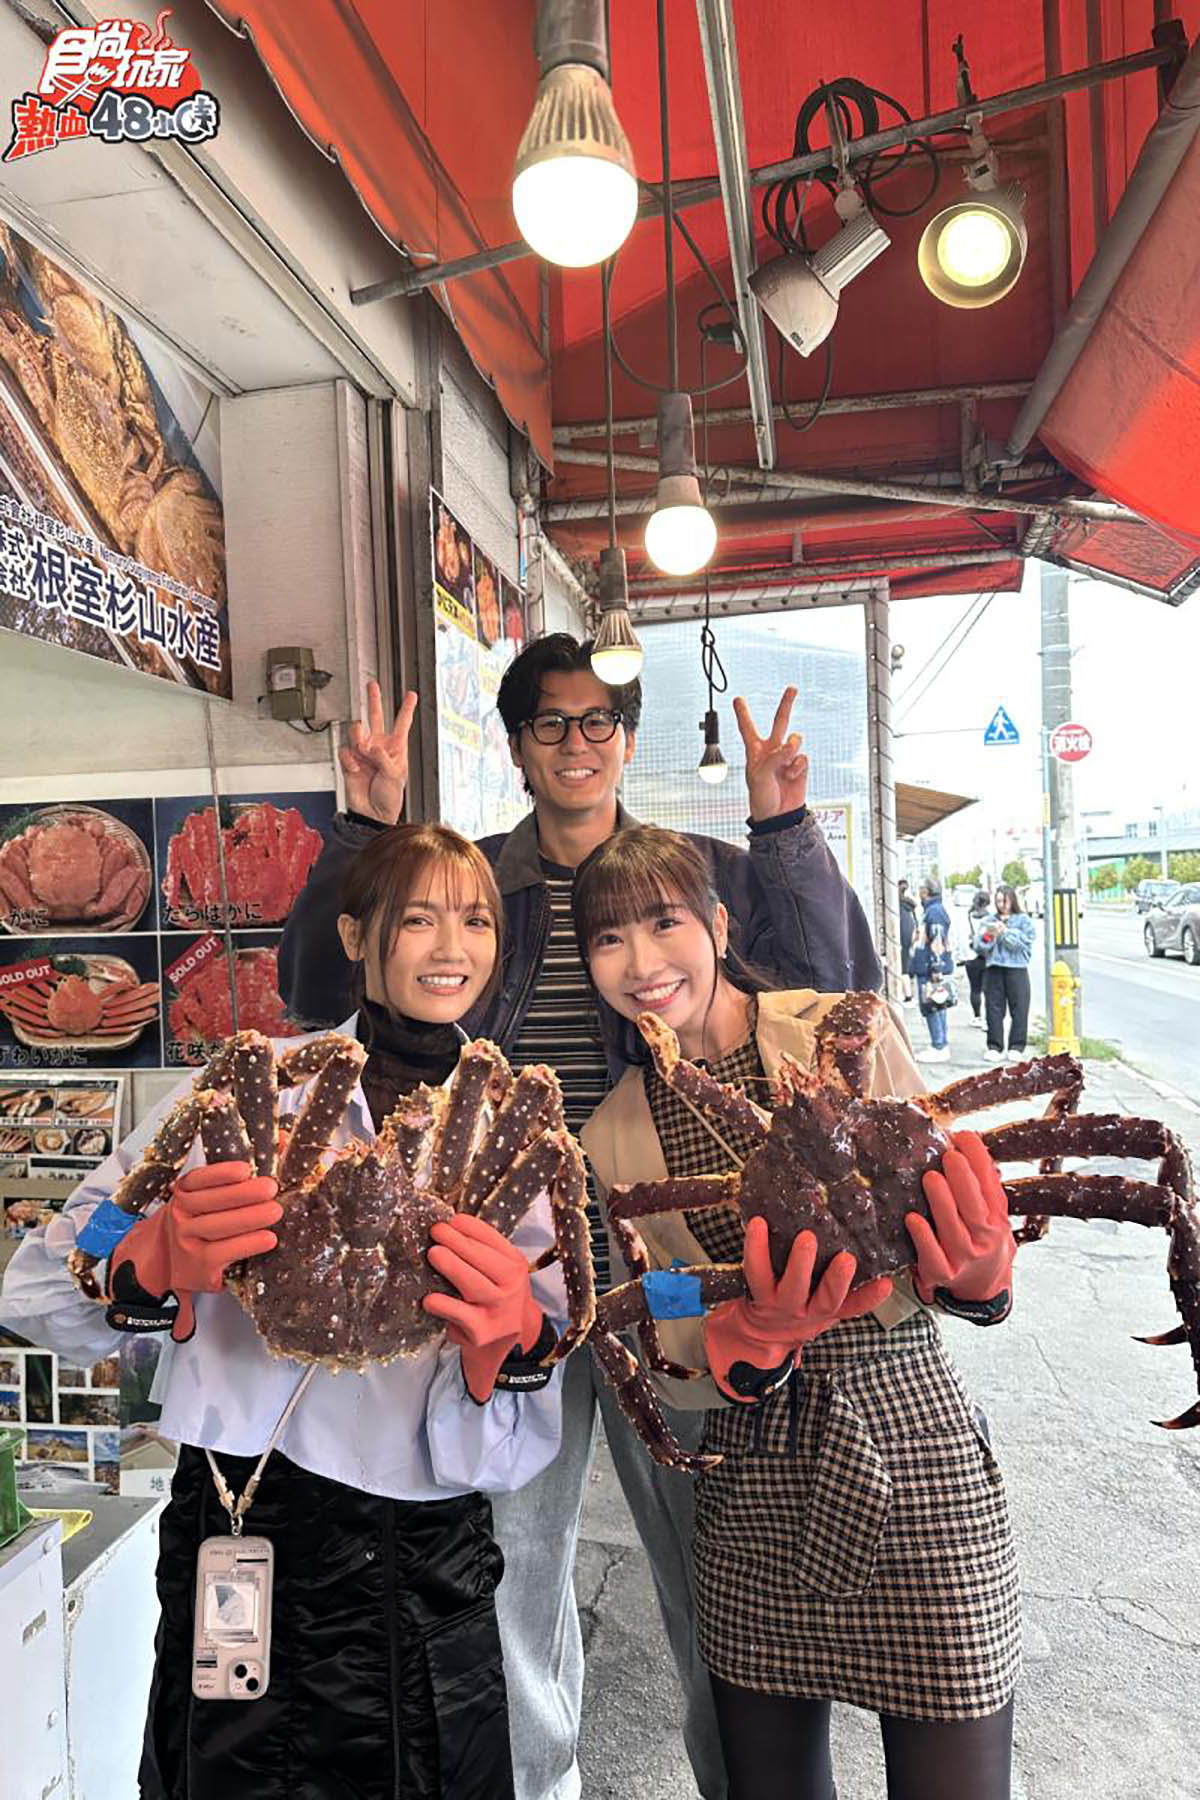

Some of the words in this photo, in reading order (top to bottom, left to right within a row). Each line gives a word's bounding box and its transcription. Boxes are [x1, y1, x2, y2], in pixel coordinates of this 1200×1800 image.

[30, 538, 220, 668] 根室杉山水産
[25, 964, 50, 979] OUT
[169, 956, 196, 983] SOLD
[195, 936, 217, 959] OUT
